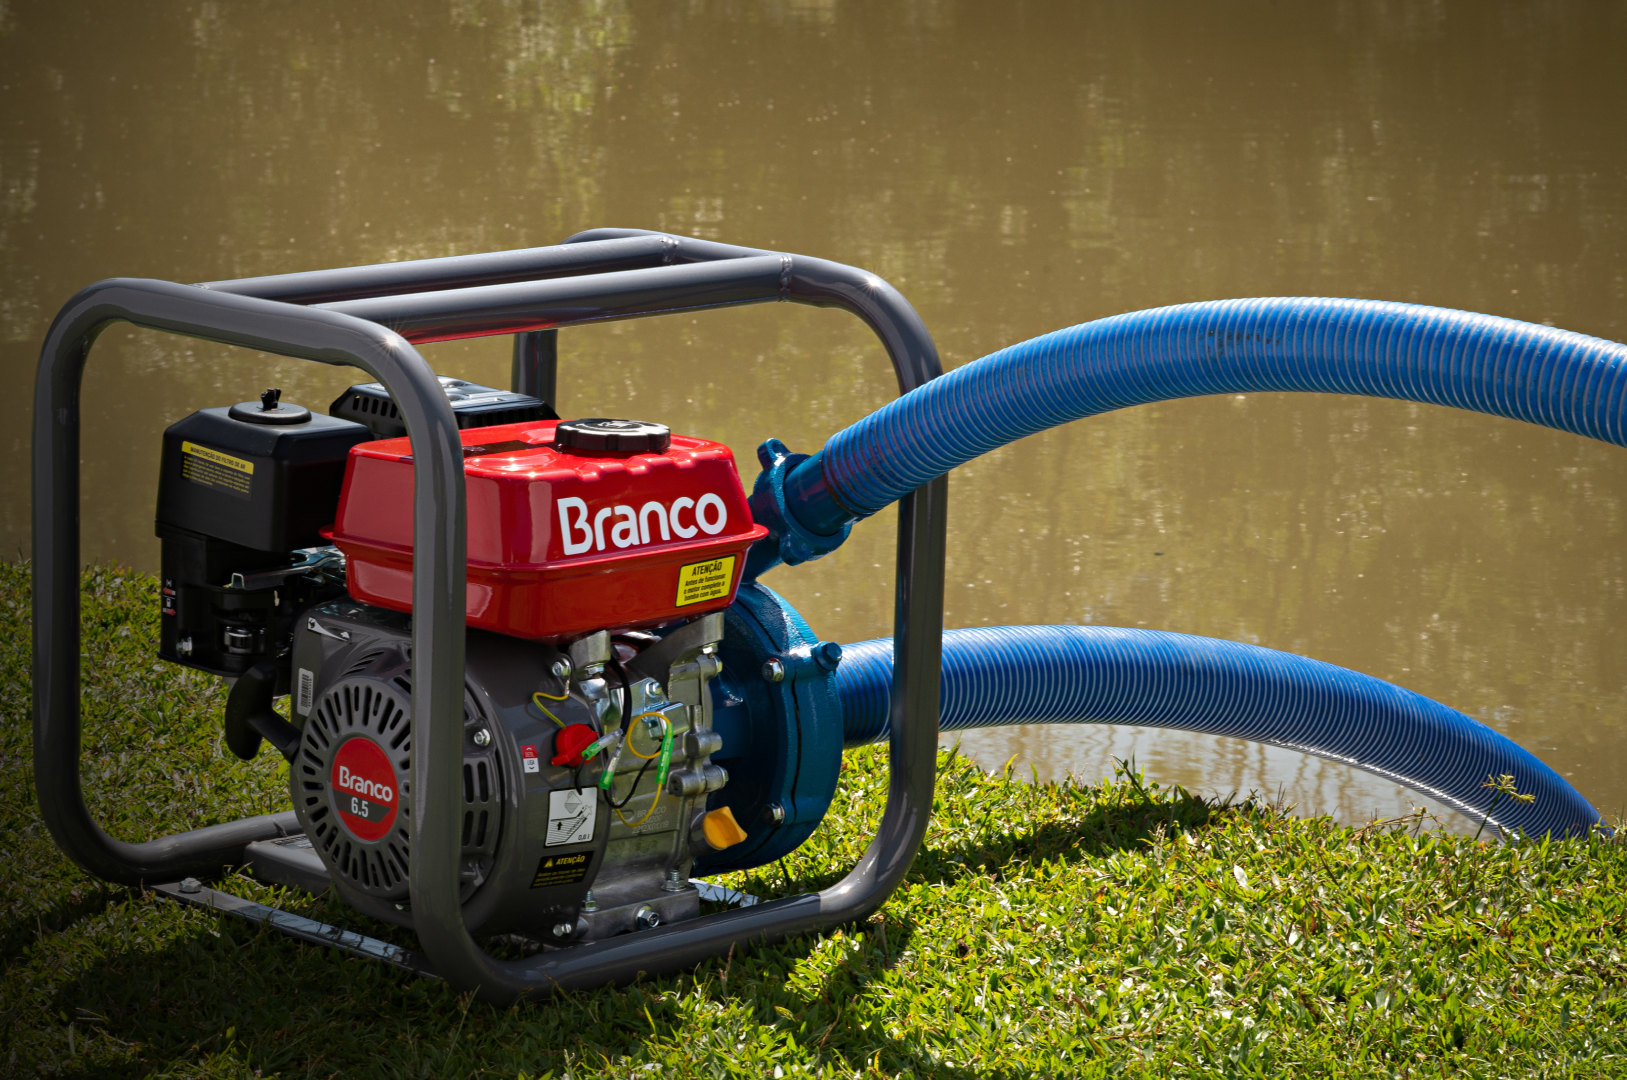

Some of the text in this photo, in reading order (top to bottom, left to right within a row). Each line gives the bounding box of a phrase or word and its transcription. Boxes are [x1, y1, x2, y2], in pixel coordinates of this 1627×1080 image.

[557, 493, 727, 556] Branco
[692, 561, 722, 576] ATENÇÃO
[704, 574, 726, 583] funcionar
[339, 765, 393, 802] Branco
[351, 797, 369, 818] 6.5
[637, 806, 667, 818] BRNCO
[556, 854, 585, 865] ATENÇÃO
